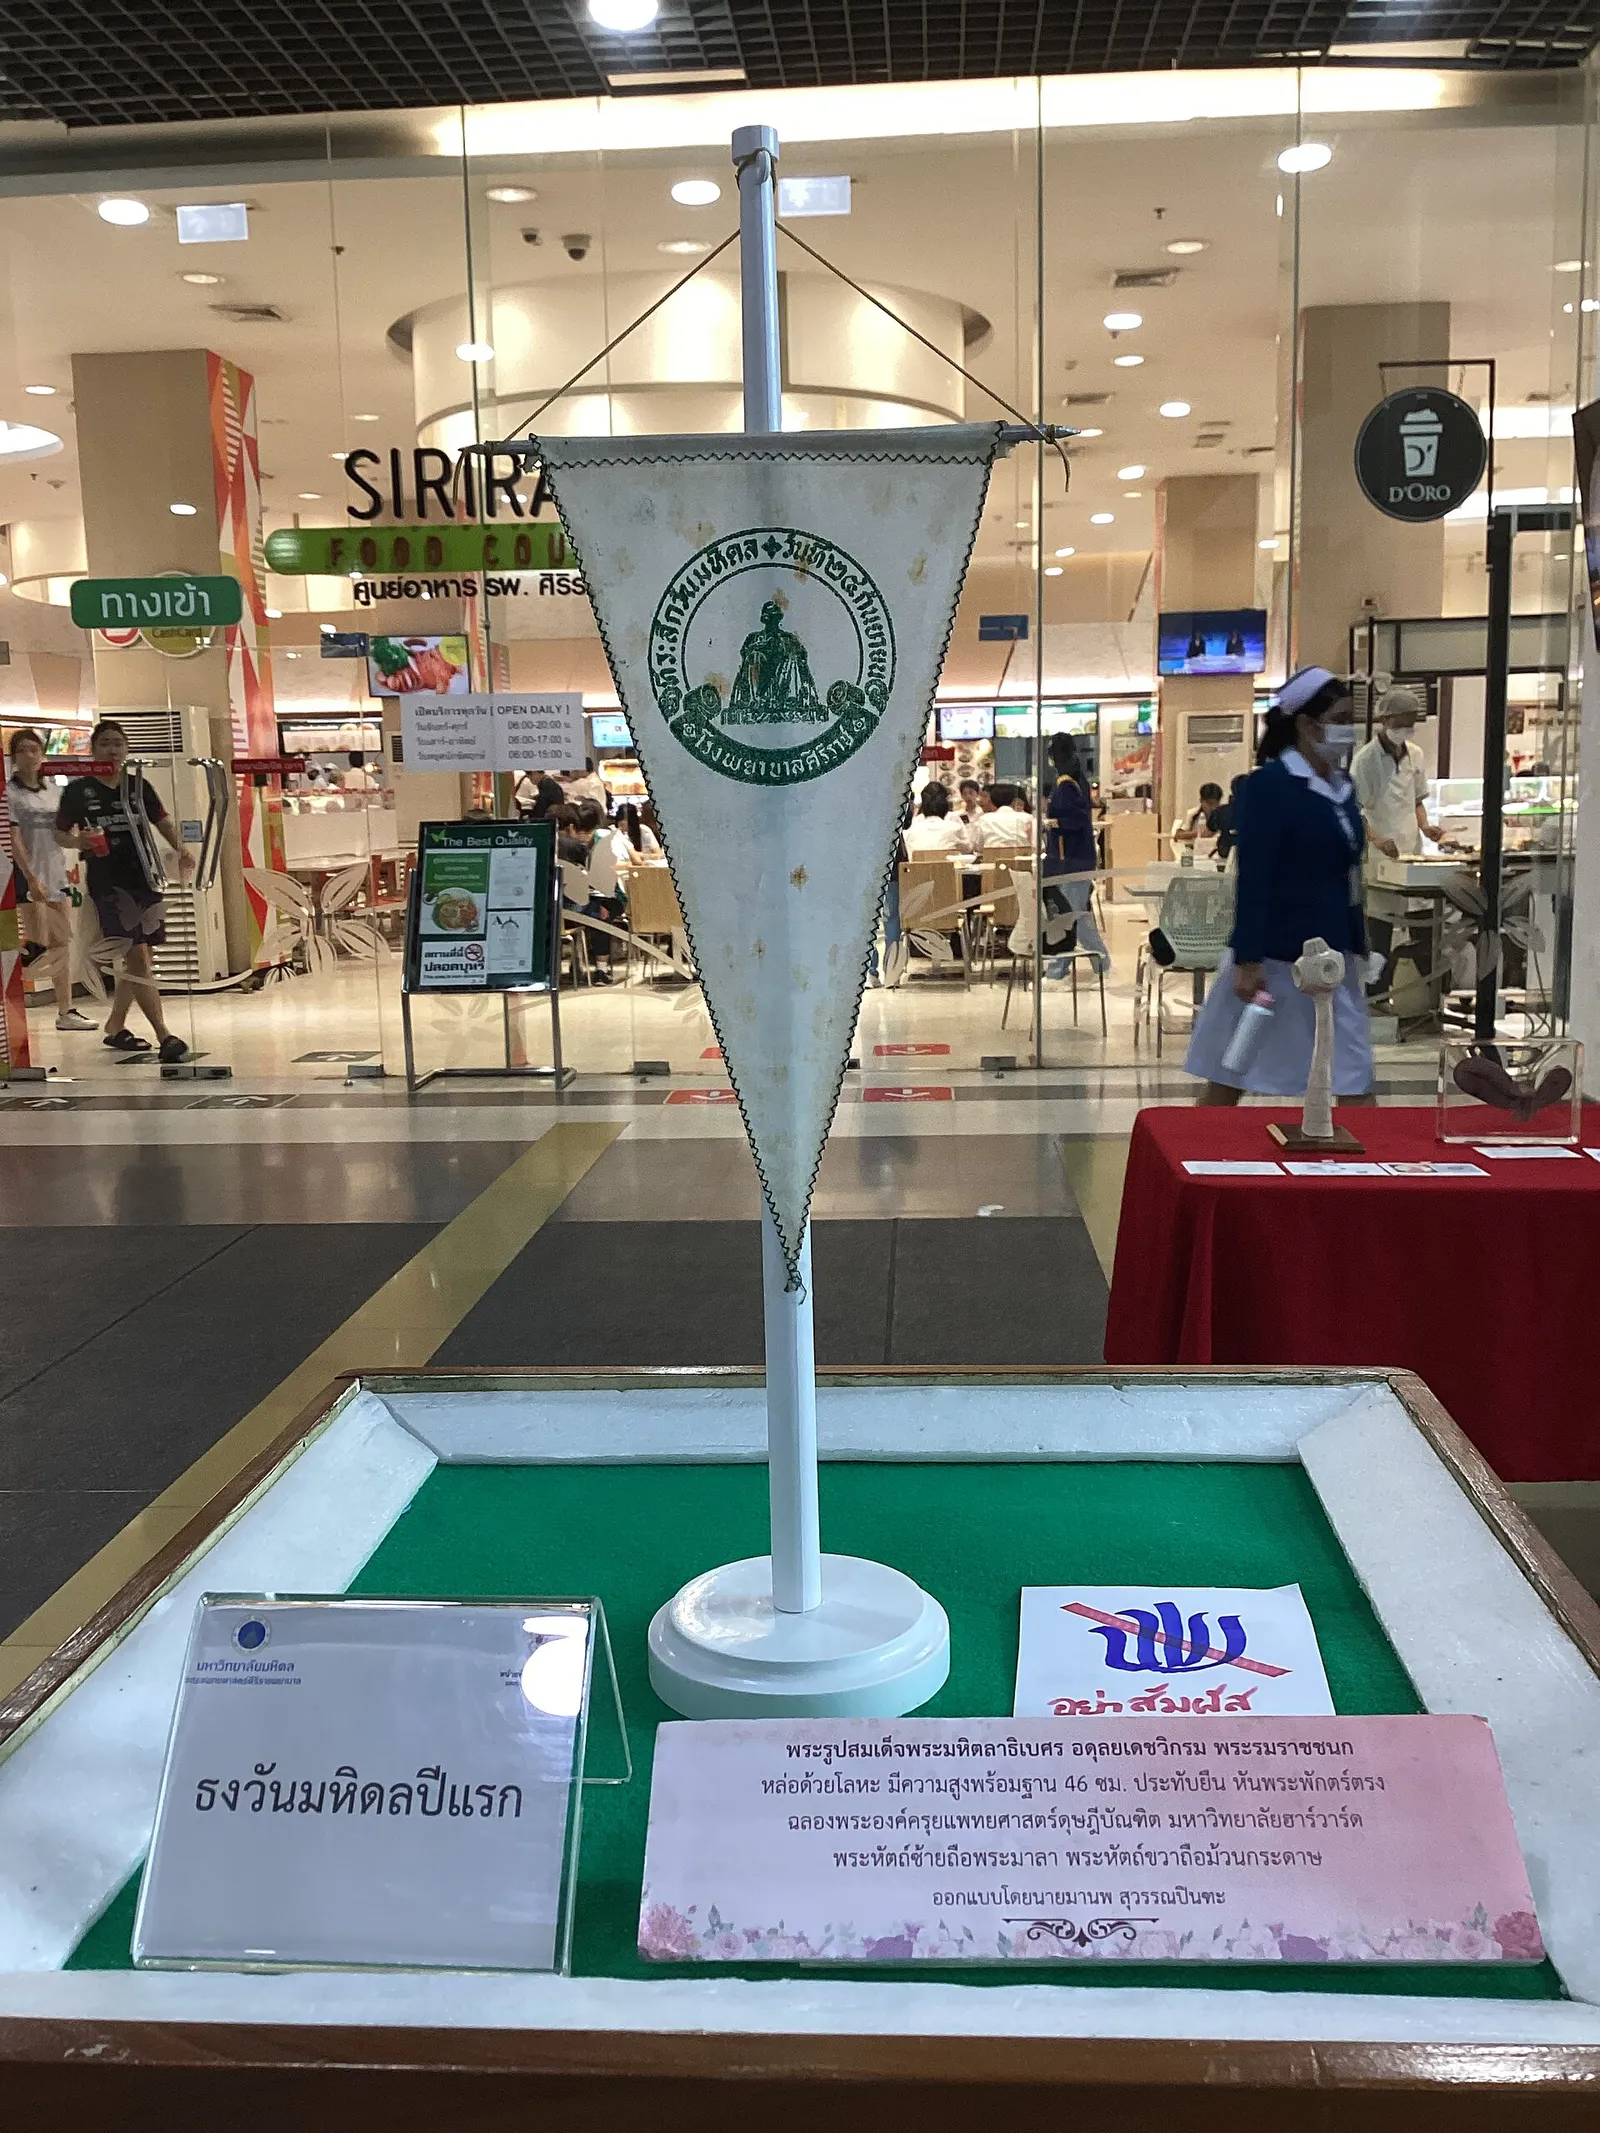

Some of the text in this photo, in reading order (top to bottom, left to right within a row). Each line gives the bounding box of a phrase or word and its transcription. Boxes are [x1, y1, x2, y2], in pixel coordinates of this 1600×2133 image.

[1388, 482, 1451, 503] D'ORO
[329, 533, 566, 568] FOOD COU
[101, 583, 211, 618] ทางเข้า
[353, 575, 478, 606] ศูนย์อาหาร
[485, 578, 529, 597] รพ.
[497, 706, 528, 715] OPEN
[531, 705, 562, 715] DAILY
[694, 723, 855, 778] โรงพยาบาลศิริราช
[443, 835, 534, 847] The Best Quality
[424, 956, 485, 973] ปลอดบุหรี่
[196, 1659, 295, 1673] มหาวิทยาลัยมหิดล
[786, 1735, 1064, 1765] พระรูปสมเด็จพระมหิตลาธิเบศร
[1071, 1736, 1207, 1763] อดุลยเดชวิกรม
[195, 1762, 523, 1818] ธงวันมหิดลปีแรก
[761, 1771, 881, 1795] หล่อด้วยโลหะ
[887, 1770, 1057, 1800] มีความสูงพร้อมฐาน
[1065, 1775, 1088, 1792] 46
[1133, 1769, 1227, 1793] ประทับยืน
[1232, 1769, 1385, 1792] หันพระพักตร์ตรง
[788, 1805, 1363, 1836] ฉลองพระองค์ครุยแพทยศาสตร์ดุษฎีบัณฑิต มหาวิทยาลัยฮาร์วาร์ด
[833, 1842, 1323, 1868] พระหัตถ์ซ้ายถือพระมาลา พระหัตถ์ขวาถือม้วนกระดาษ
[932, 1884, 1113, 1906] ออกแบบโดยนายมานพ
